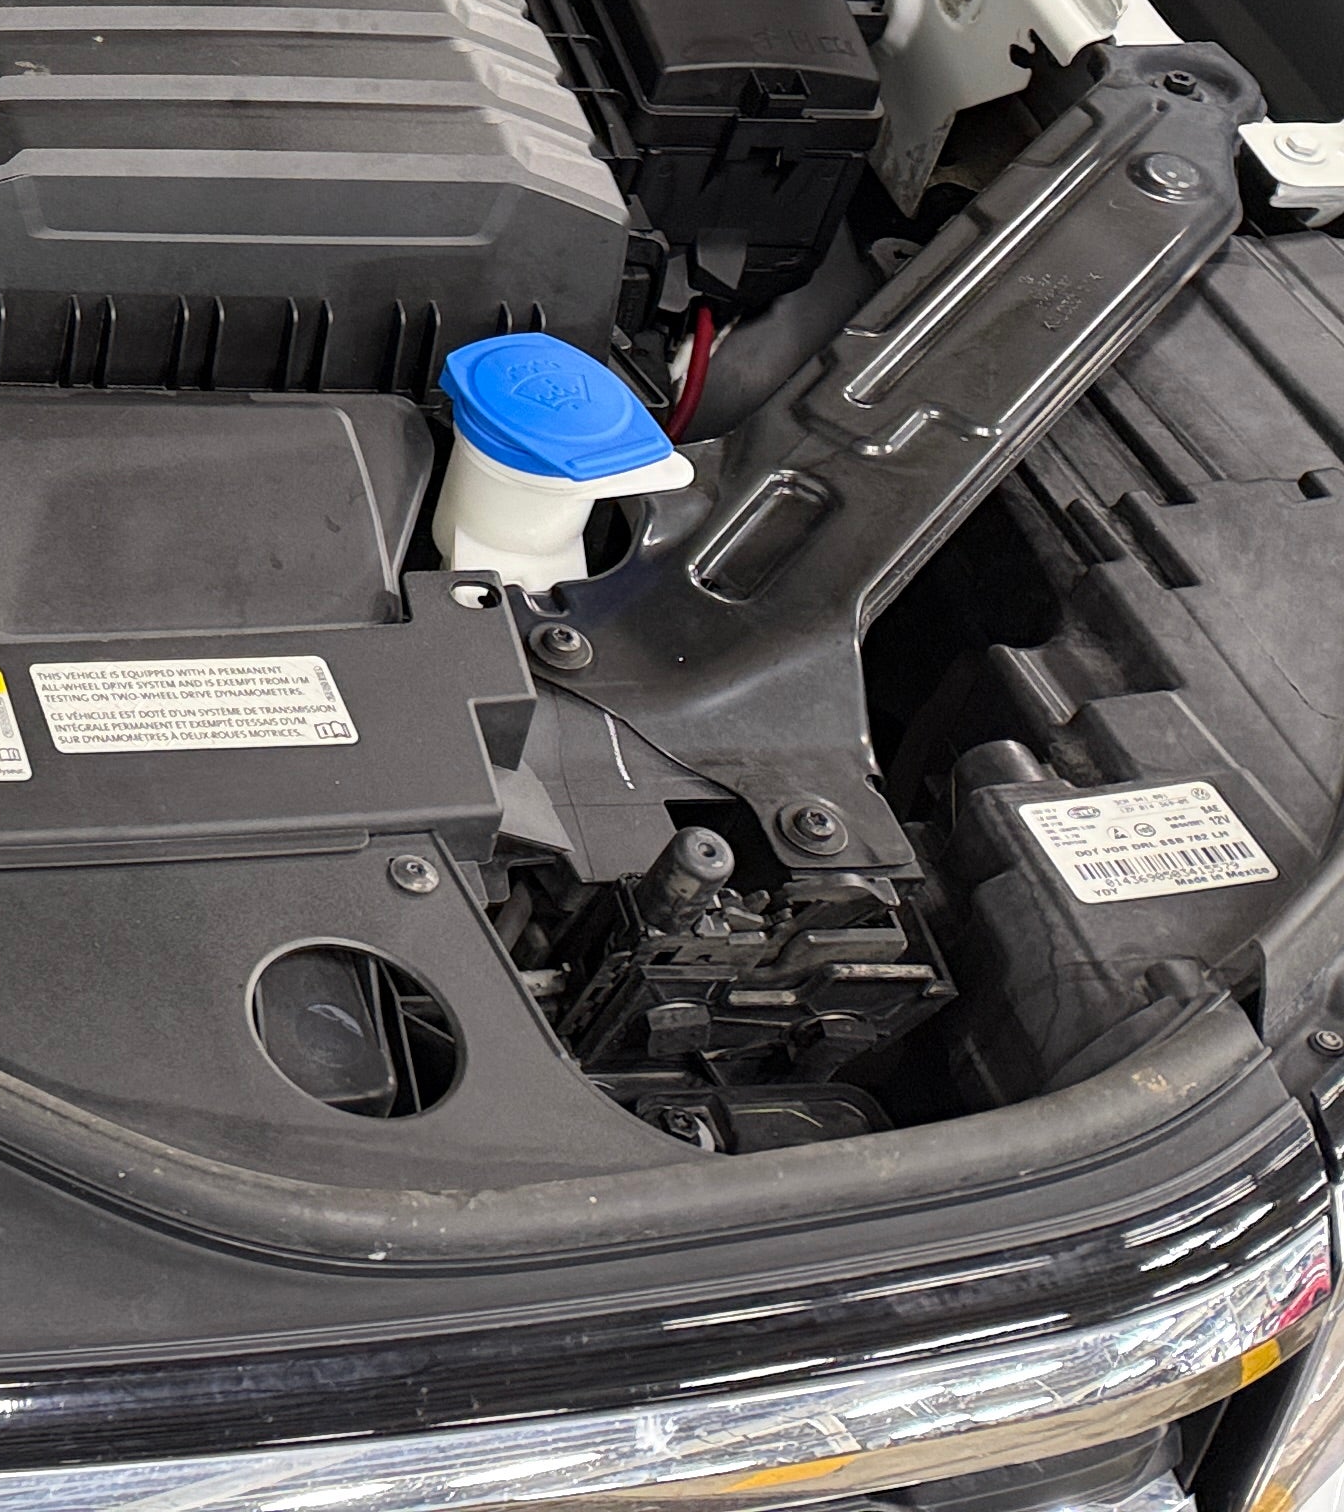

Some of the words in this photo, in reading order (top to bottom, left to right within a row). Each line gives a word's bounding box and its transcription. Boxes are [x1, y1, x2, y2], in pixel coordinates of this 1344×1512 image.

[37, 672, 62, 681] THIS
[63, 671, 107, 680] VEHICLE
[110, 670, 119, 679] IS
[122, 669, 175, 679] EQUIPPED
[176, 668, 206, 677] WITH
[208, 668, 216, 676] A
[218, 666, 282, 676] PERMANENT
[102, 681, 133, 690] DRIVE
[136, 680, 176, 689] SYSTEM
[179, 679, 202, 688] AND
[205, 679, 213, 687] IS
[217, 678, 256, 687] EXEMPT
[259, 677, 289, 686] FROM
[45, 694, 90, 703] TESTING
[92, 693, 109, 702] ON
[180, 690, 213, 699] DRIVE
[51, 713, 63, 721] CE
[65, 711, 115, 721] VÉHICULE
[119, 710, 136, 719] EST
[139, 708, 167, 718] DOTÉ
[169, 708, 196, 717] D'UN
[199, 707, 242, 716] SYSTÈME
[244, 707, 257, 715] DE
[259, 705, 337, 714] TRANSMISSION
[54, 723, 110, 732] INTÉGRALE
[111, 721, 172, 731] PERMANENT
[175, 720, 186, 729] ET
[190, 718, 232, 728] EXEMPTÉ
[235, 718, 278, 727] D'ESSAIS
[58, 736, 80, 744] SUR
[82, 732, 169, 743] DYNAMOMÈTRES
[1200, 805, 1222, 814] SAE
[1209, 814, 1230, 825] 12V
[1075, 848, 1099, 858] DOT
[1102, 846, 1129, 854] VOR
[1131, 842, 1158, 850] DRL
[1211, 830, 1229, 839] LH
[1174, 876, 1208, 886] Made
[1225, 868, 1270, 878] Mexico
